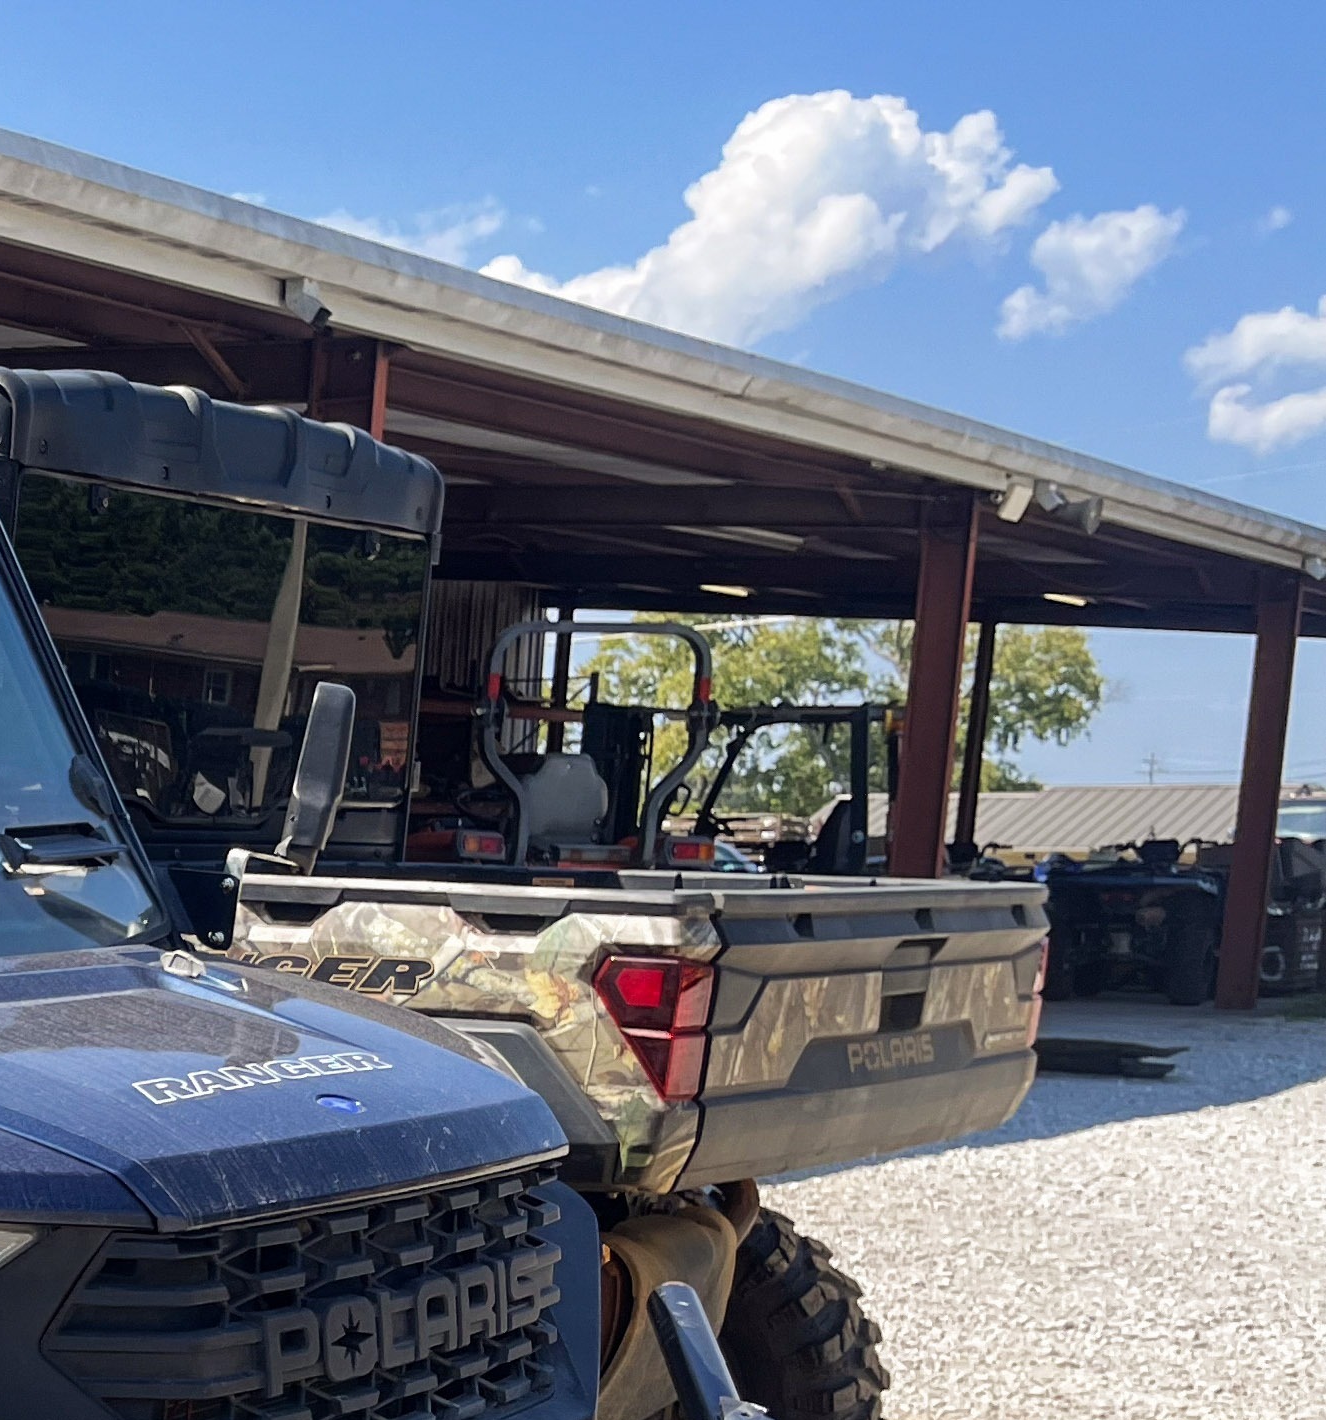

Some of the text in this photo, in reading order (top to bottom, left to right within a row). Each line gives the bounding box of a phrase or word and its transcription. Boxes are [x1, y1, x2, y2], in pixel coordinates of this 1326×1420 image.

[131, 1051, 394, 1106] RANGER
[847, 1031, 935, 1074] POLARIS
[259, 1250, 545, 1398] POLARIS
